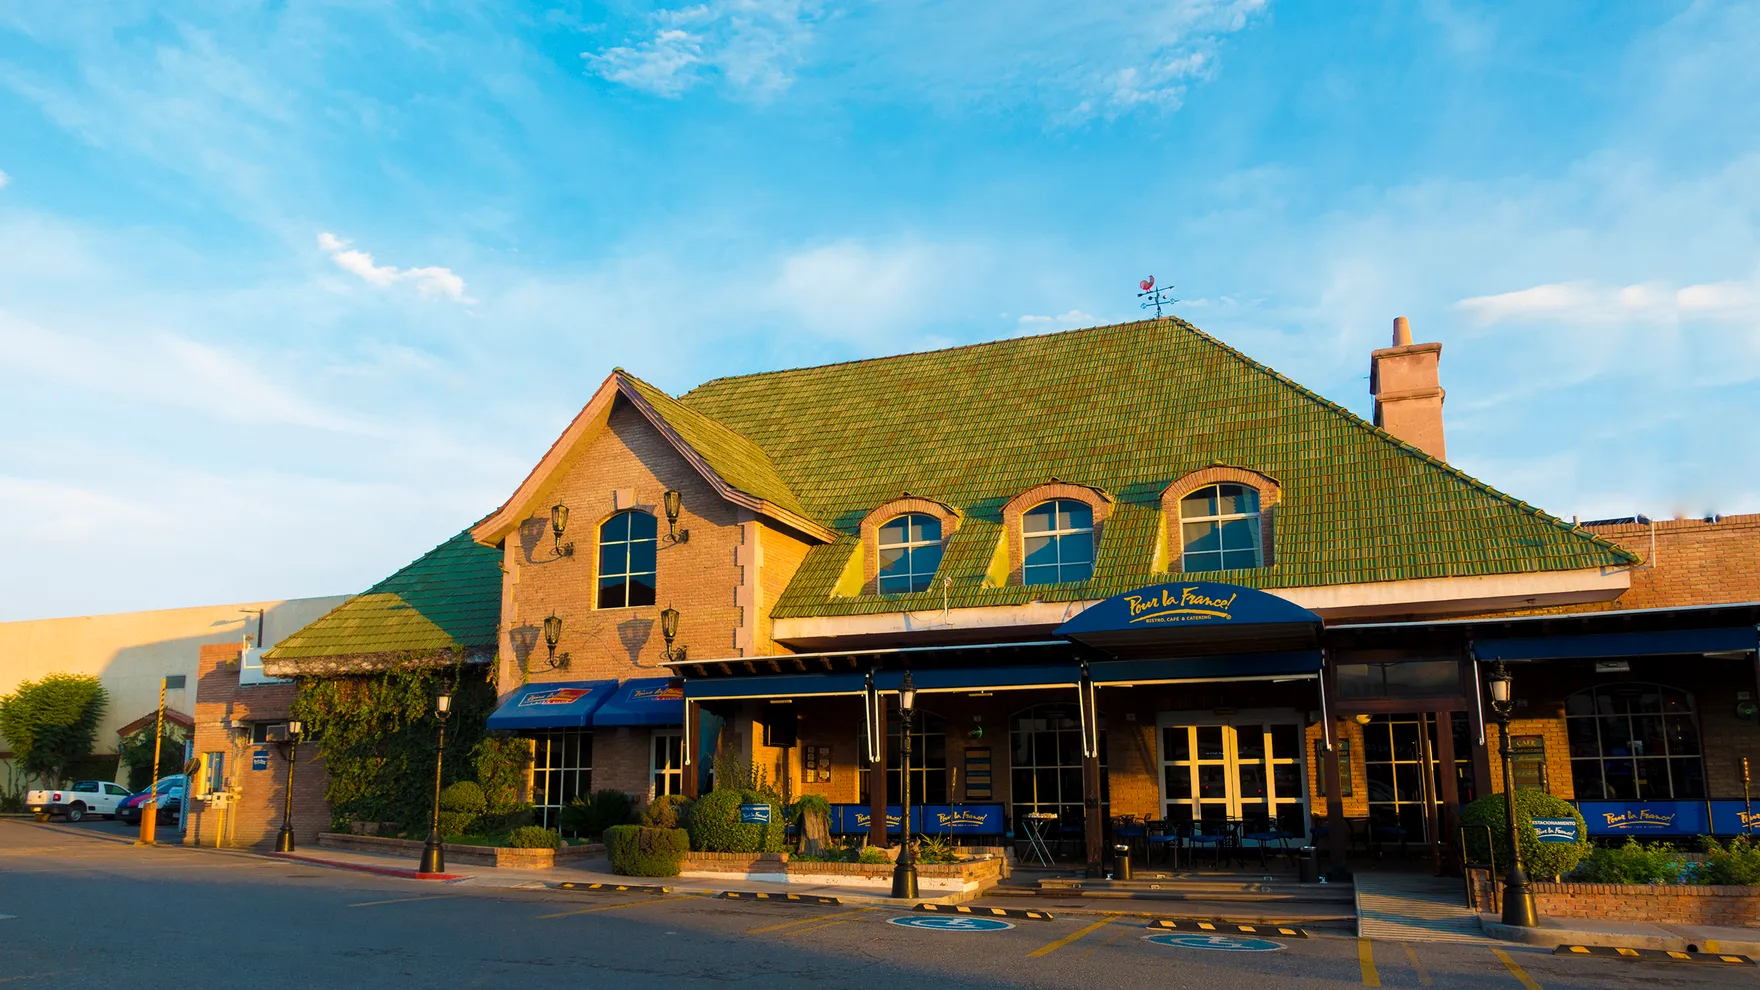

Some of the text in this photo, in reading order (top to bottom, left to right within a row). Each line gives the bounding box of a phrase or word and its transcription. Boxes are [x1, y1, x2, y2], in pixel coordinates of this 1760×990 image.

[1124, 586, 1237, 616] Pour la France!
